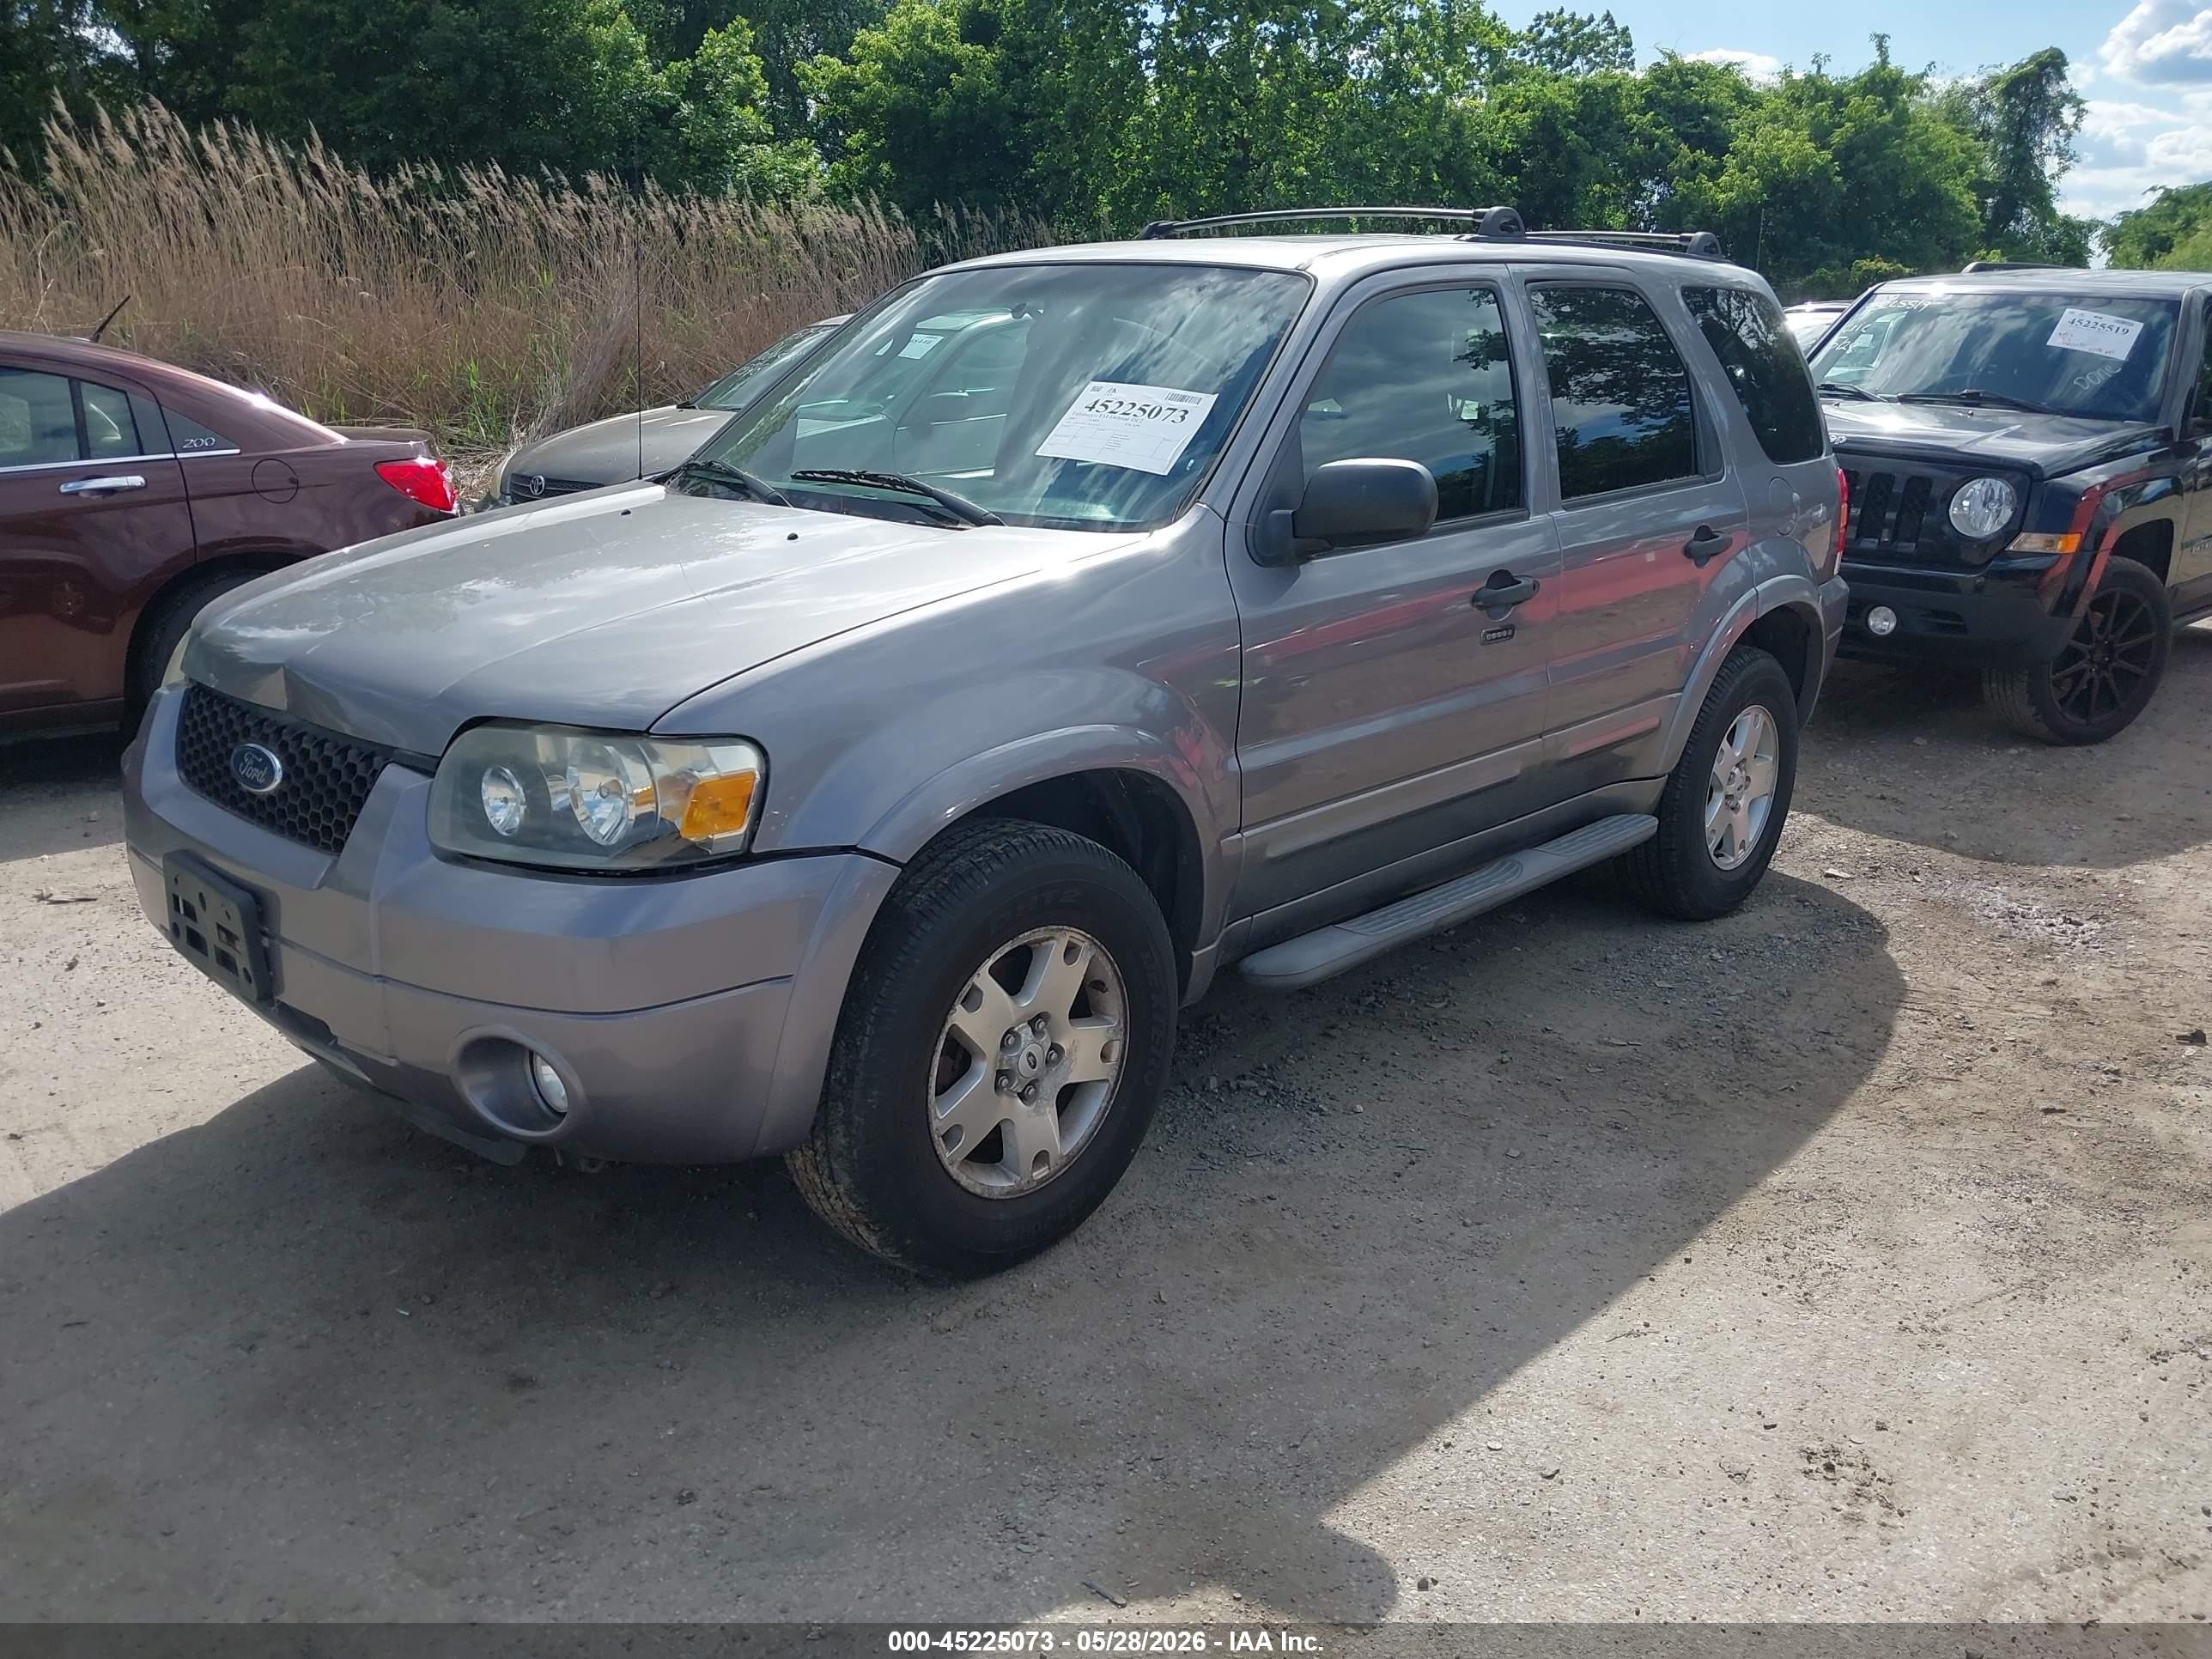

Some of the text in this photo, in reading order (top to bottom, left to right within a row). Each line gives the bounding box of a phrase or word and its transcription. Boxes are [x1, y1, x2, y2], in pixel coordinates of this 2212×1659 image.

[2068, 317, 2130, 335] 45225519
[1085, 398, 1189, 424] 45225073
[182, 437, 216, 448] 200
[239, 751, 268, 783] Ford
